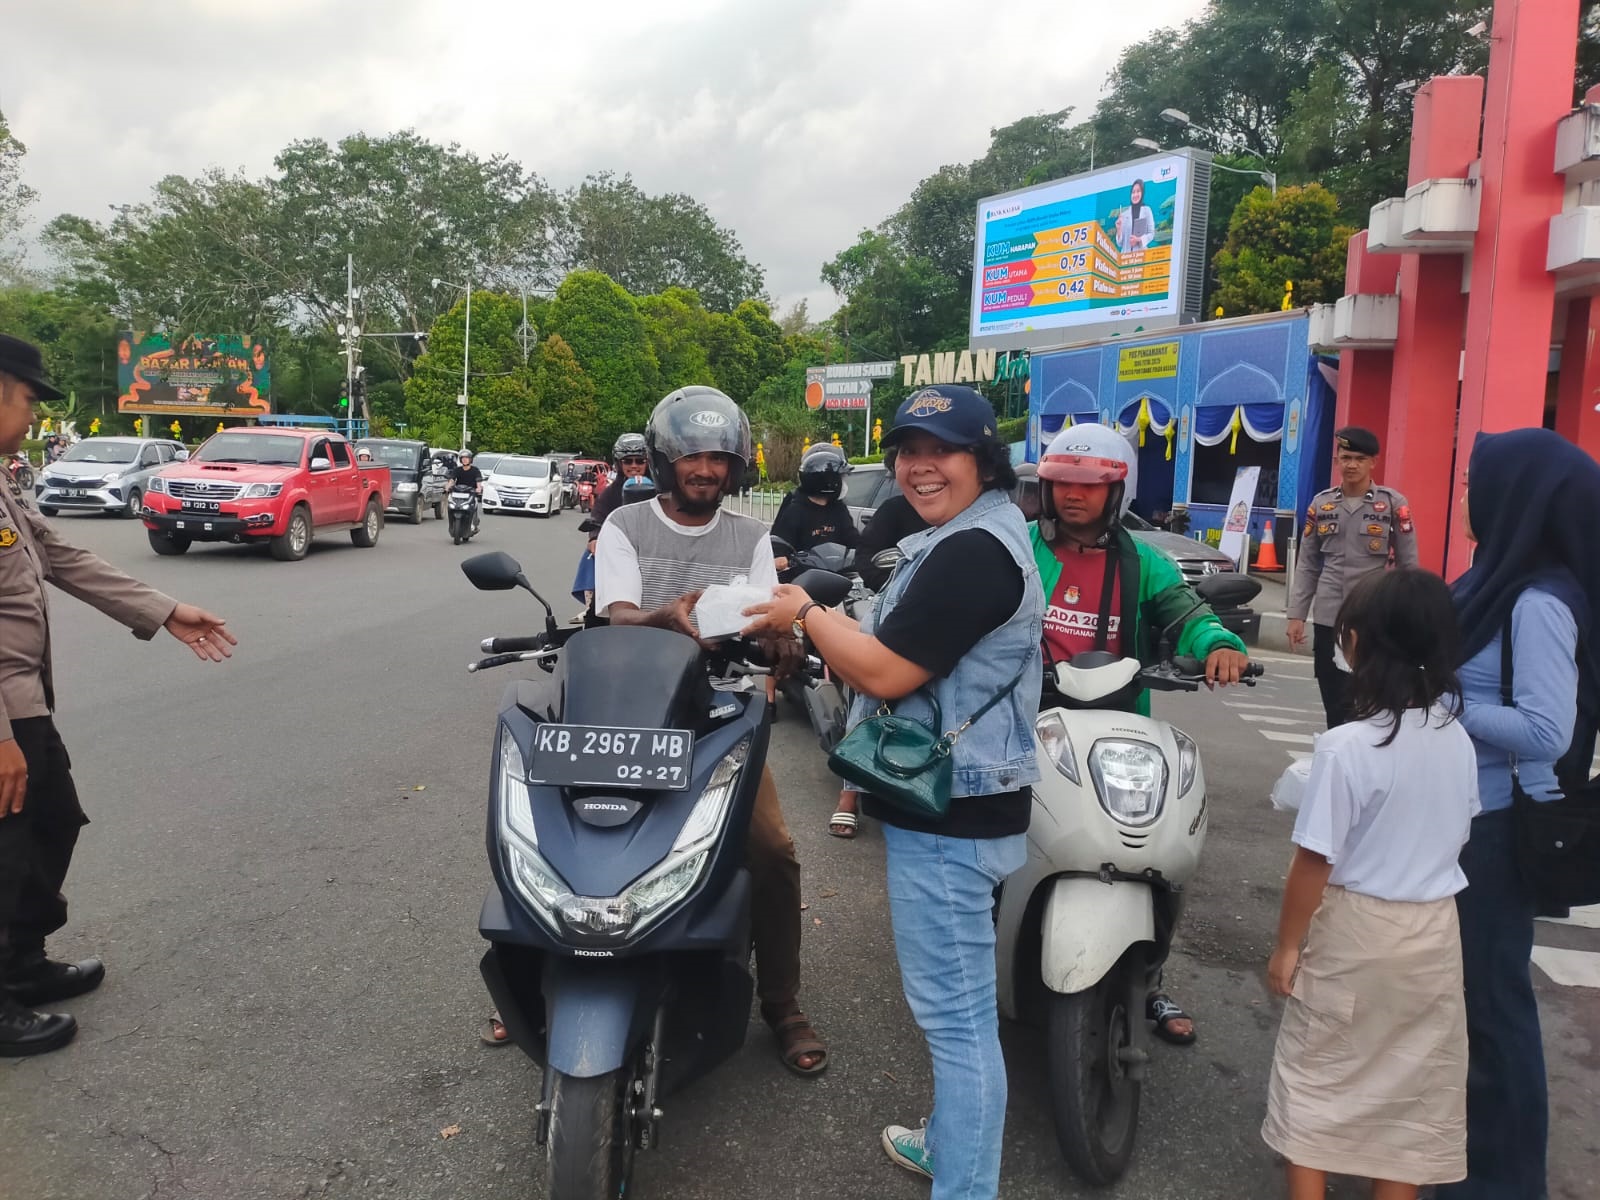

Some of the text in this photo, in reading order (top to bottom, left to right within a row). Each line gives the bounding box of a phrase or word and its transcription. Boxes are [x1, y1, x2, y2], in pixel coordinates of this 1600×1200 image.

[986, 242, 1036, 257] KUM HARAPAN
[985, 266, 1028, 281] KUM UTAMA
[984, 290, 1007, 306] KUM
[1007, 293, 1028, 302] PEDULI
[826, 366, 861, 378] RUMAH
[862, 363, 893, 376] SAKIT
[901, 348, 996, 386] TAMAN
[826, 381, 858, 394] UNTAN
[1363, 513, 1391, 522] POLRI
[540, 730, 683, 758] KB 2967 MB
[584, 803, 628, 811] HONDA
[574, 949, 614, 957] HONDA
